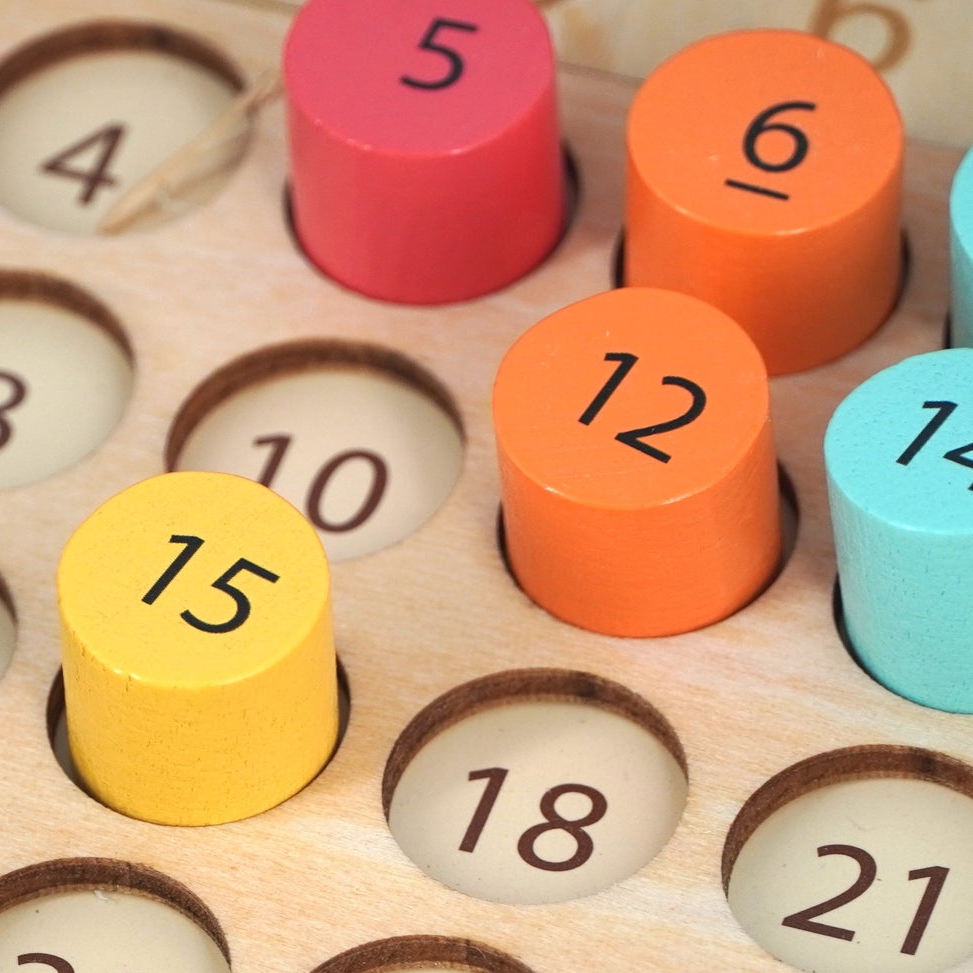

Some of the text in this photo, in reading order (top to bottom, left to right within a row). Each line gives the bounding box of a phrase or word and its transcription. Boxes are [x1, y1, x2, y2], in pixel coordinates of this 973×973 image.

[399, 18, 479, 91] 5
[41, 121, 130, 207] 4
[741, 101, 817, 174] 6
[578, 352, 708, 464] 12
[895, 400, 973, 492] 1
[249, 433, 390, 534] 10
[141, 534, 280, 634] 15
[457, 767, 608, 872] 18
[781, 844, 951, 956] 21
